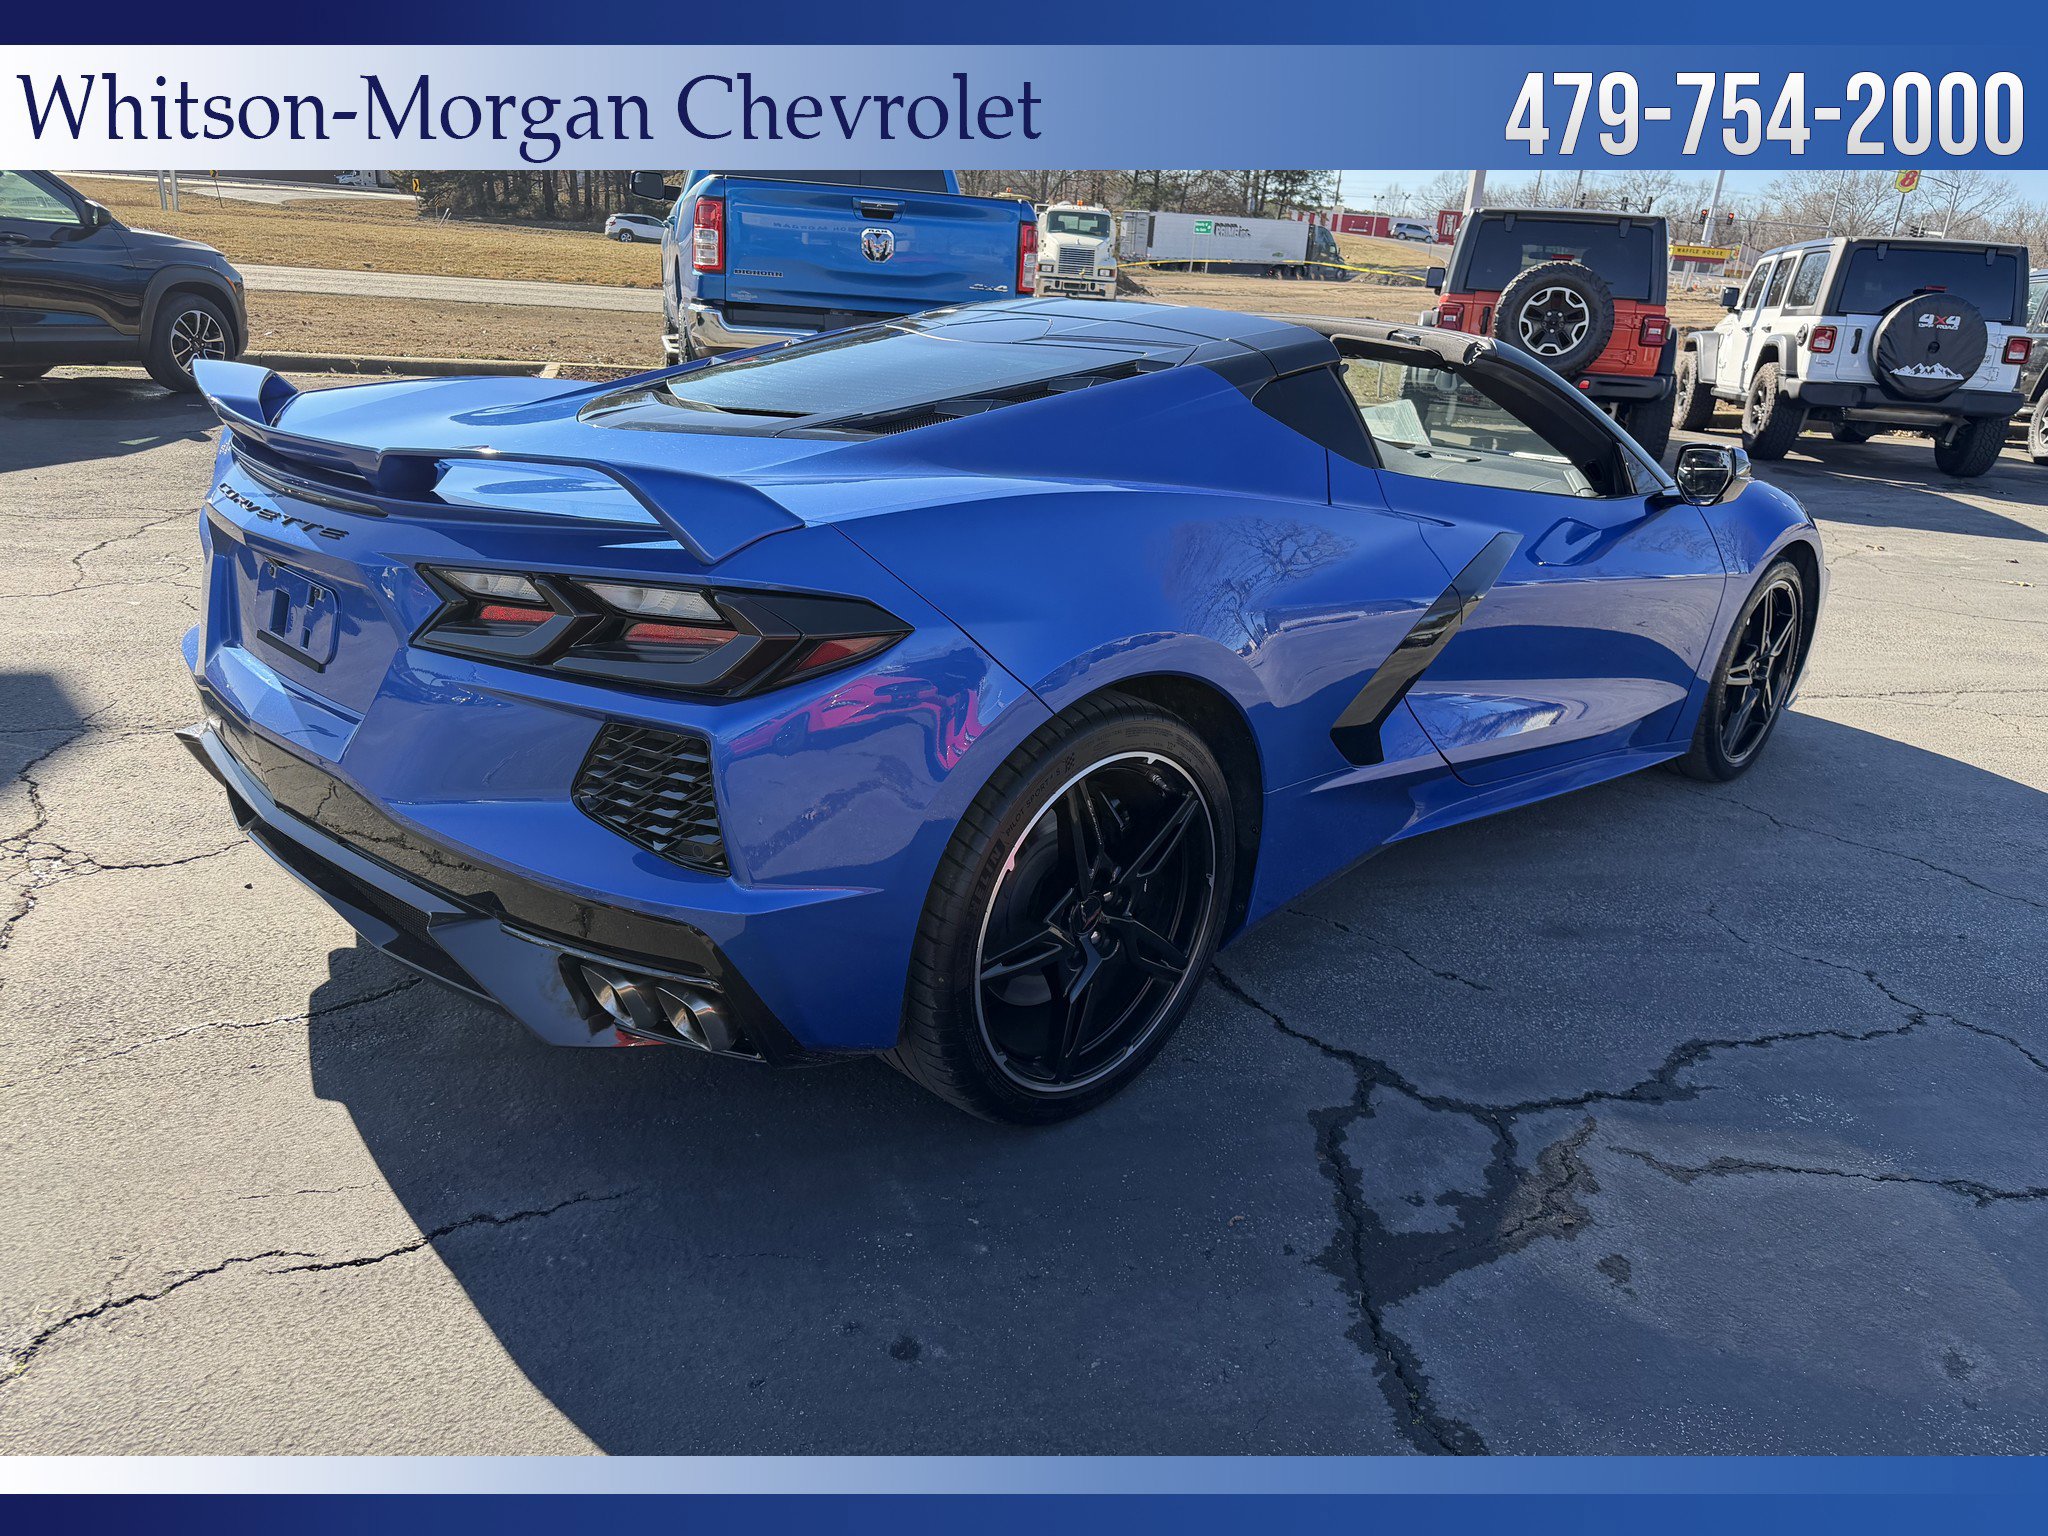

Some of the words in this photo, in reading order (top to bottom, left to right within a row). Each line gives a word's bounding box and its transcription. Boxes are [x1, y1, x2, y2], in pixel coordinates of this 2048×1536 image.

[1900, 170, 1918, 187] 8
[1677, 247, 1699, 255] WAFFLE
[1702, 249, 1723, 257] HOUSE
[217, 482, 350, 541] CORVETTE
[1025, 776, 1049, 809] SPORT
